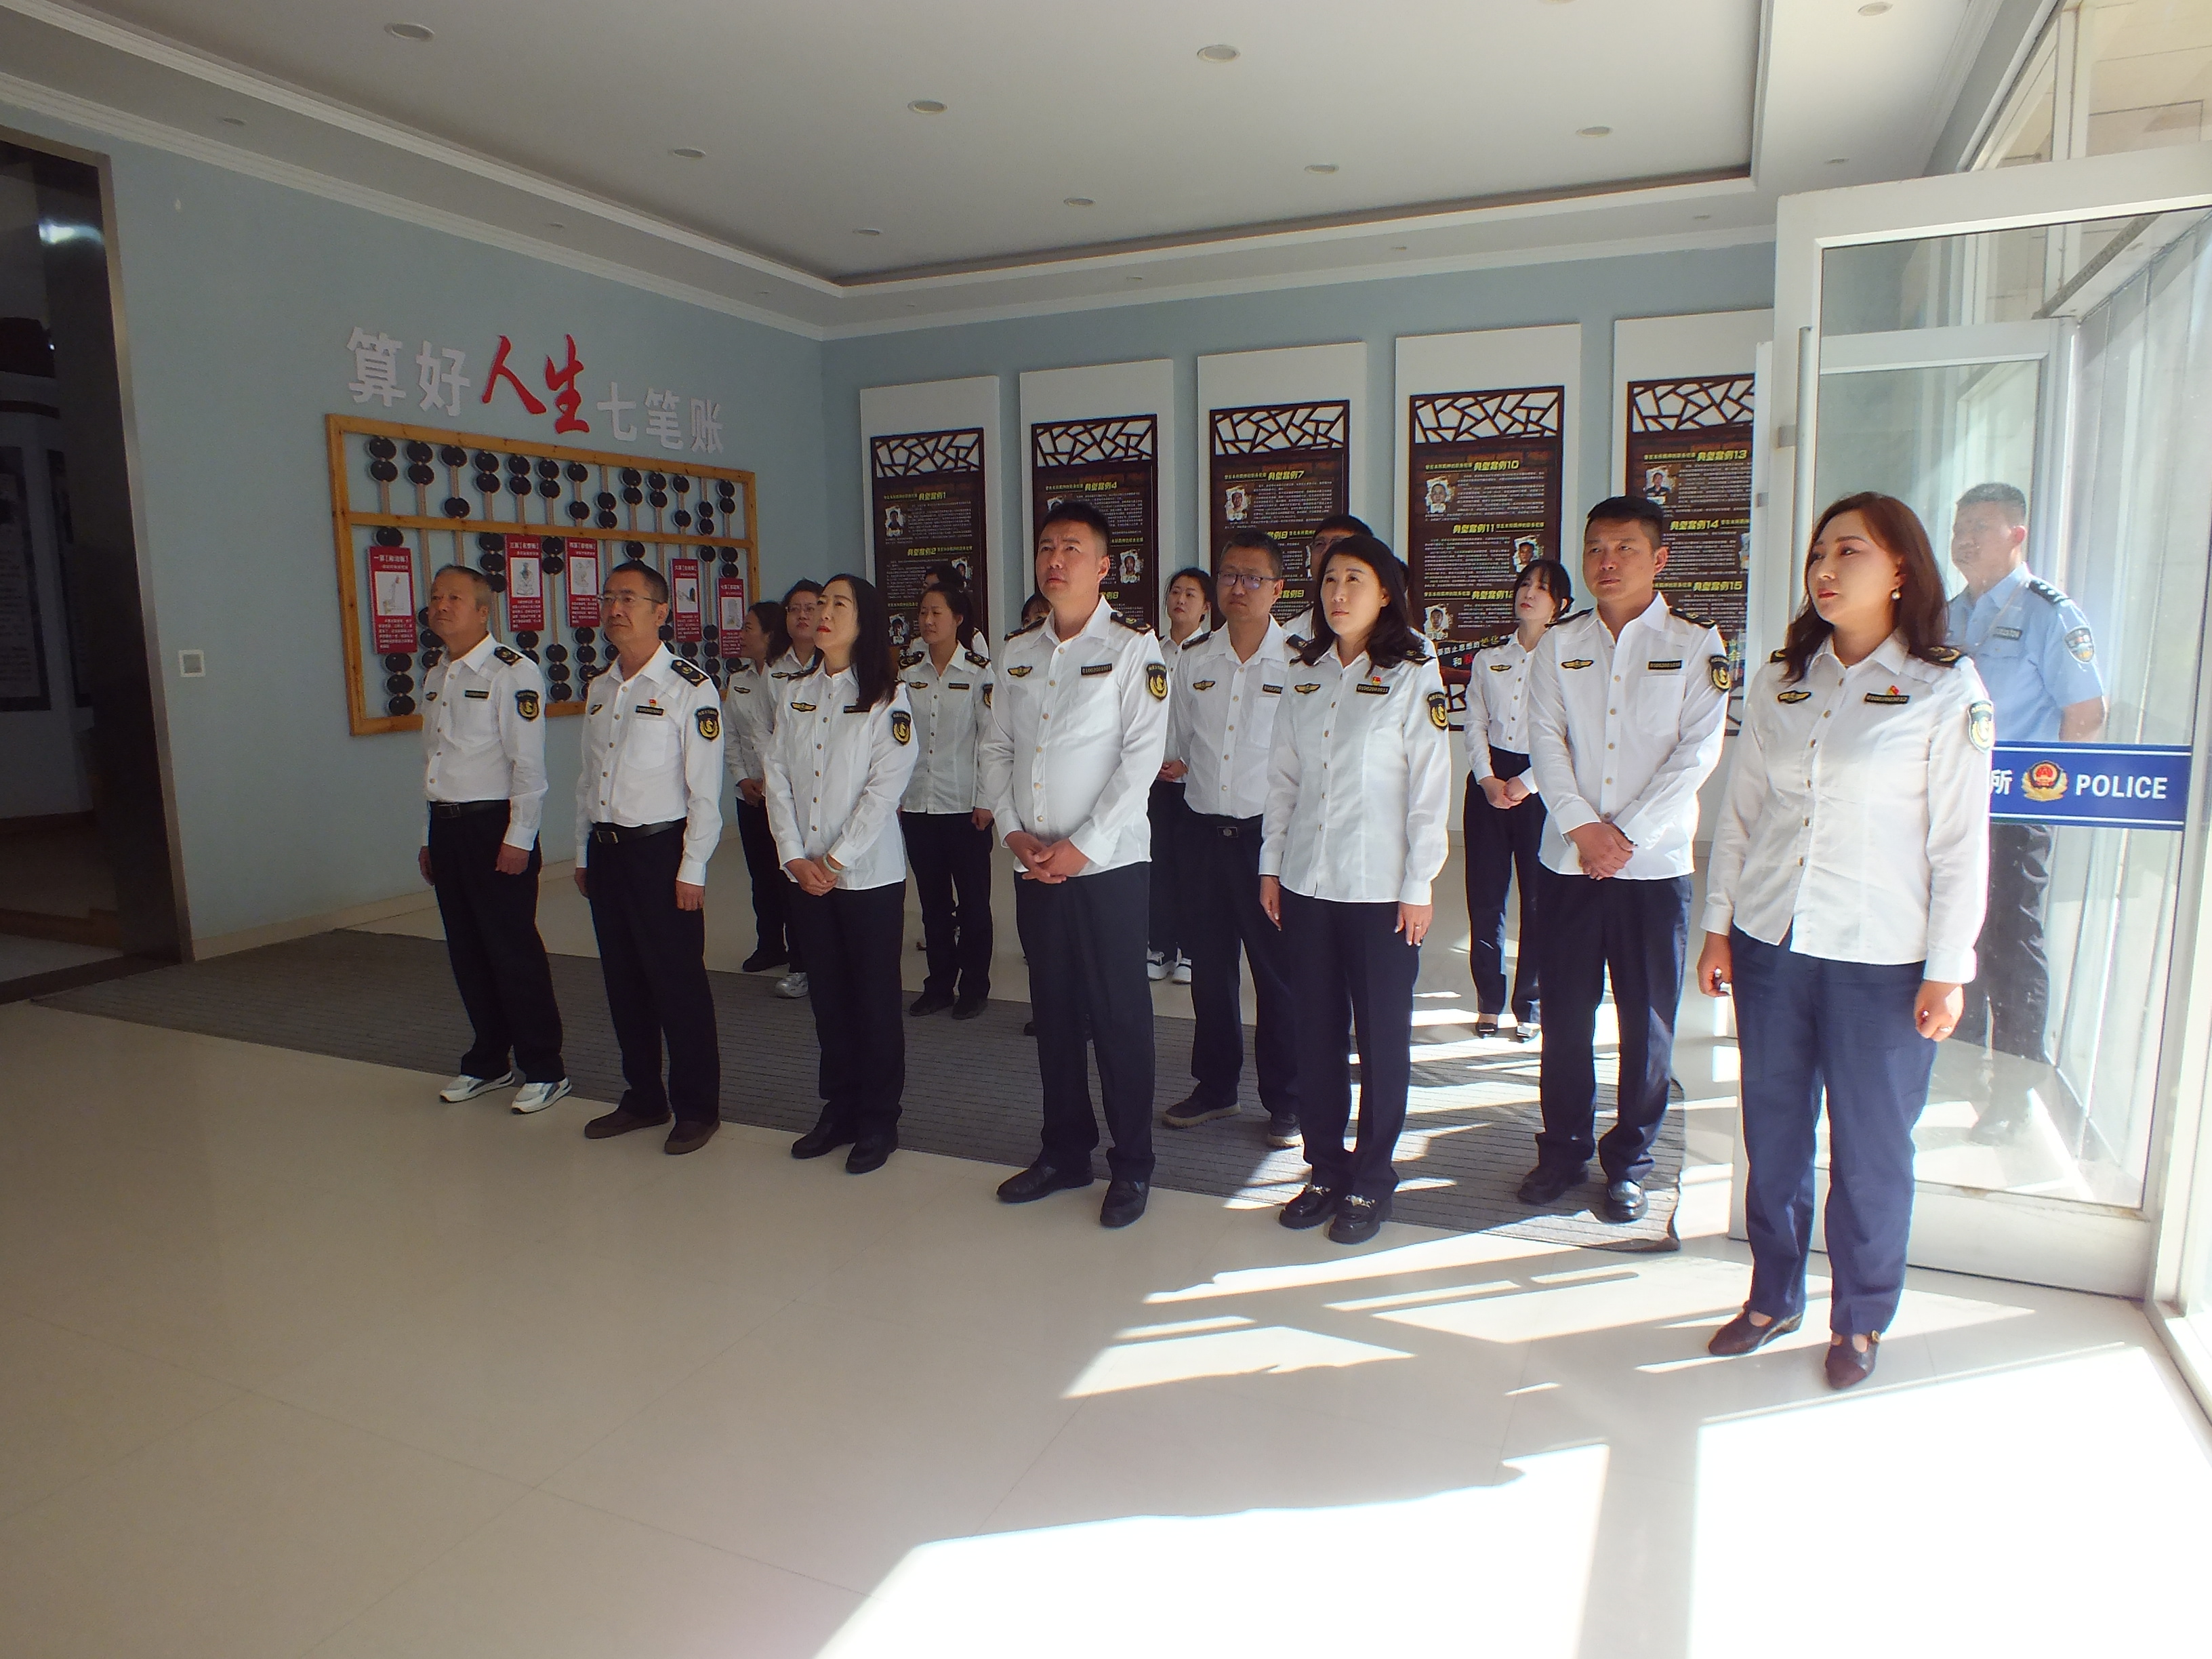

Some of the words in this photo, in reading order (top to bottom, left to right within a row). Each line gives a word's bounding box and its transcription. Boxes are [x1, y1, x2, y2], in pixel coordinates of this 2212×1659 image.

[346, 326, 723, 453] 算好人生七笔账
[1696, 450, 1747, 461] 典型案例13
[1474, 460, 1519, 471] 典型案例10
[1453, 523, 1495, 533] 典型案例11
[1670, 520, 1719, 530] 典型案例14
[1693, 581, 1743, 591] 典型案例15
[1991, 769, 2013, 795] 所
[2075, 774, 2168, 799] POLICE
